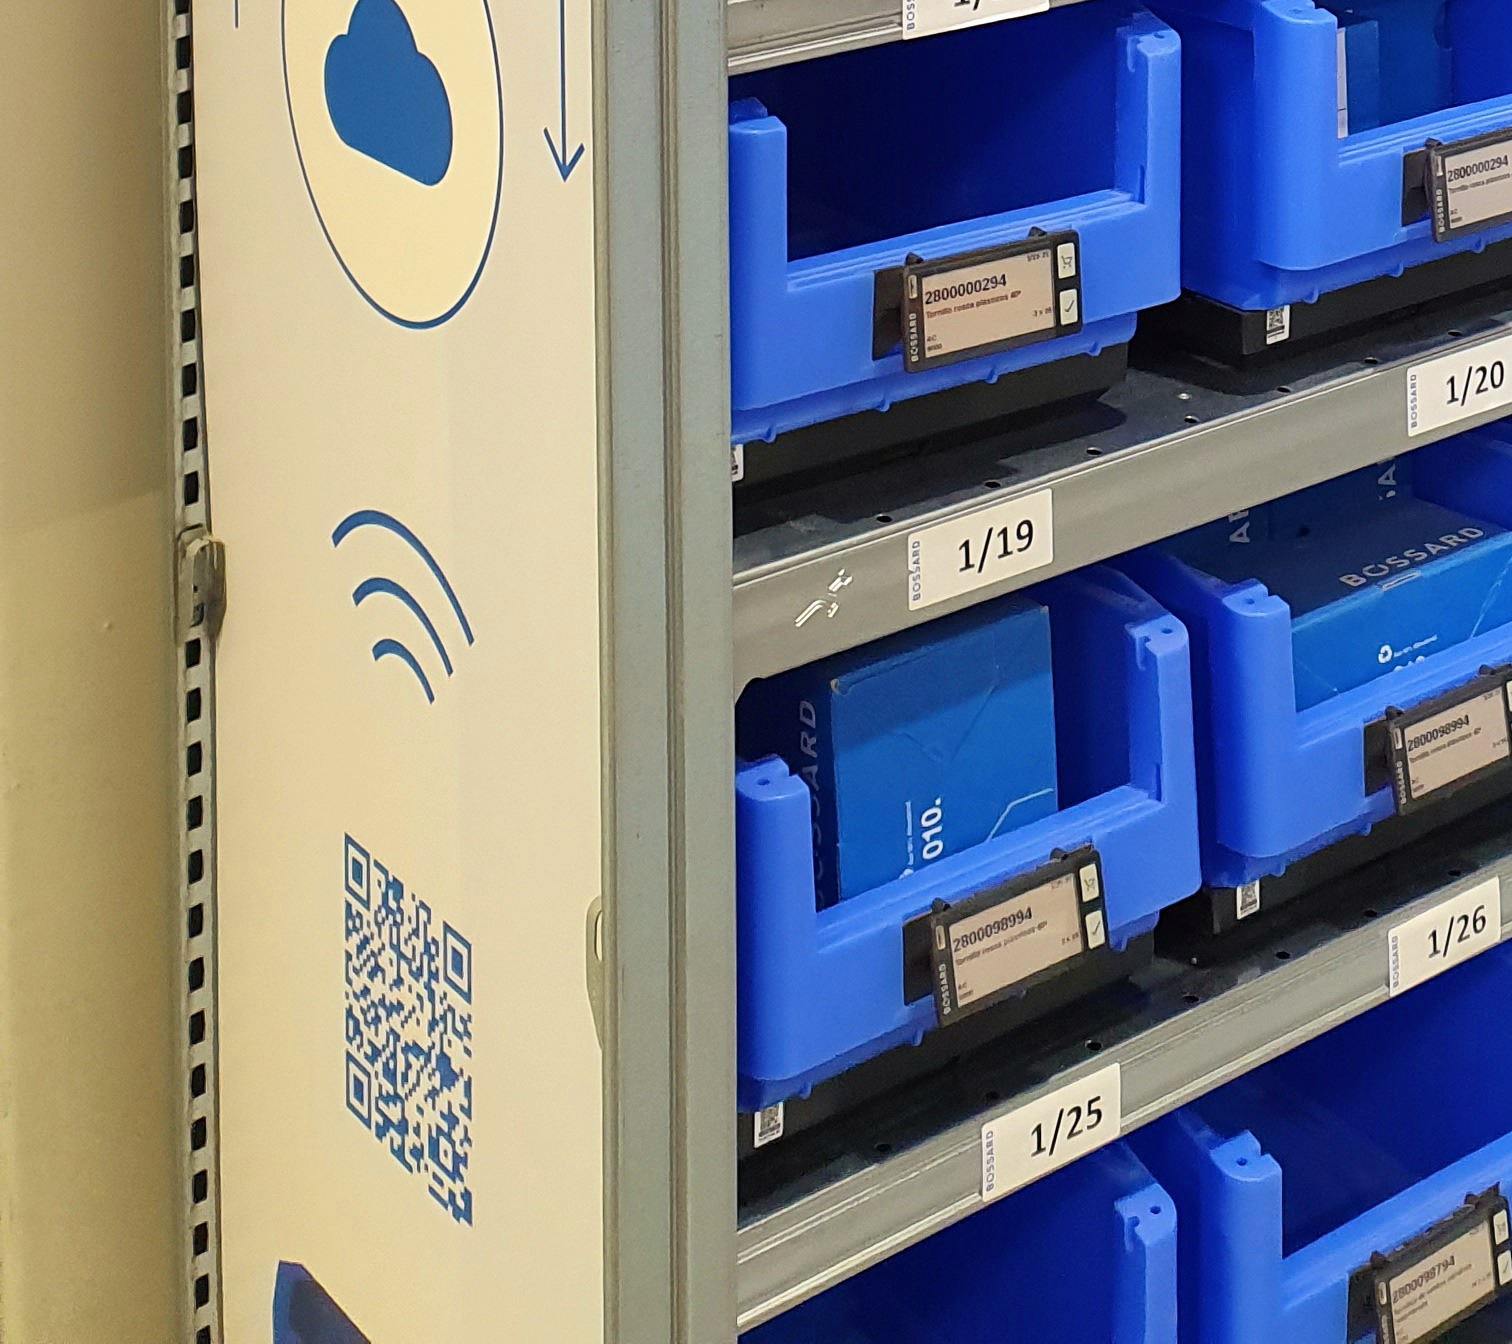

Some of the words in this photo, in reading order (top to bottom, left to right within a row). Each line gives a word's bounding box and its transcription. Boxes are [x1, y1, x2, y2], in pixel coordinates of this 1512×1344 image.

[1447, 154, 1509, 182] 2800000294
[924, 273, 1007, 304] 2800000294
[910, 313, 918, 361] BOSSARD
[1447, 360, 1504, 407] 1/20
[912, 540, 921, 601] BOSSARD
[958, 519, 1033, 574] 1/19
[1339, 527, 1485, 588] BOSSARD
[1407, 715, 1469, 752] 2800098994
[921, 798, 943, 860] 010.
[953, 907, 1033, 952] 2800098994
[1391, 936, 1399, 989] BOSSARD
[1428, 906, 1486, 958] 1/26
[986, 1131, 995, 1193] BOSSARD
[1031, 1097, 1104, 1157] 1/25
